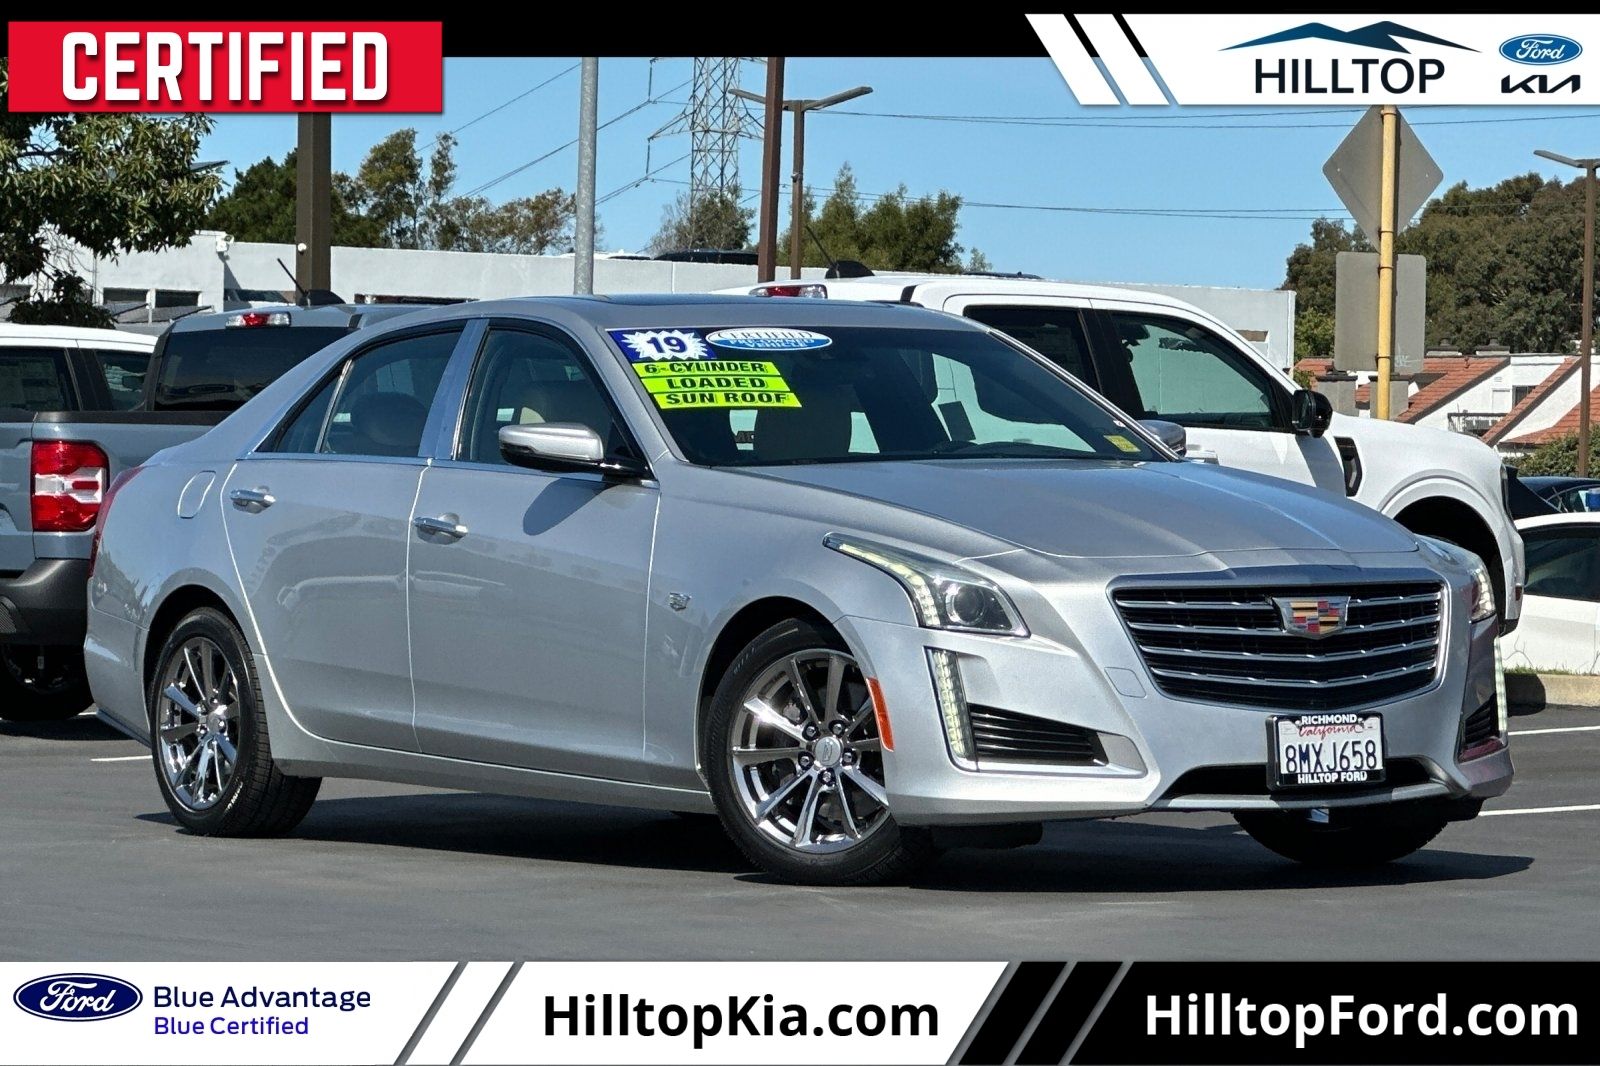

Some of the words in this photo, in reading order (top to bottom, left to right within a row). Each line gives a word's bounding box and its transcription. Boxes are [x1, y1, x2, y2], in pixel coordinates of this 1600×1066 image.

[646, 336, 687, 353] 19
[643, 362, 767, 374] 6-CYLINDER
[667, 378, 766, 389] LOADED
[666, 392, 716, 404] SUN
[725, 393, 787, 404] ROOF
[1301, 714, 1358, 725] RICHMOND
[1299, 725, 1363, 739] California
[1285, 739, 1378, 773] 8MXJ658
[1297, 771, 1339, 784] HILLTOP
[1340, 770, 1368, 783] FORD
